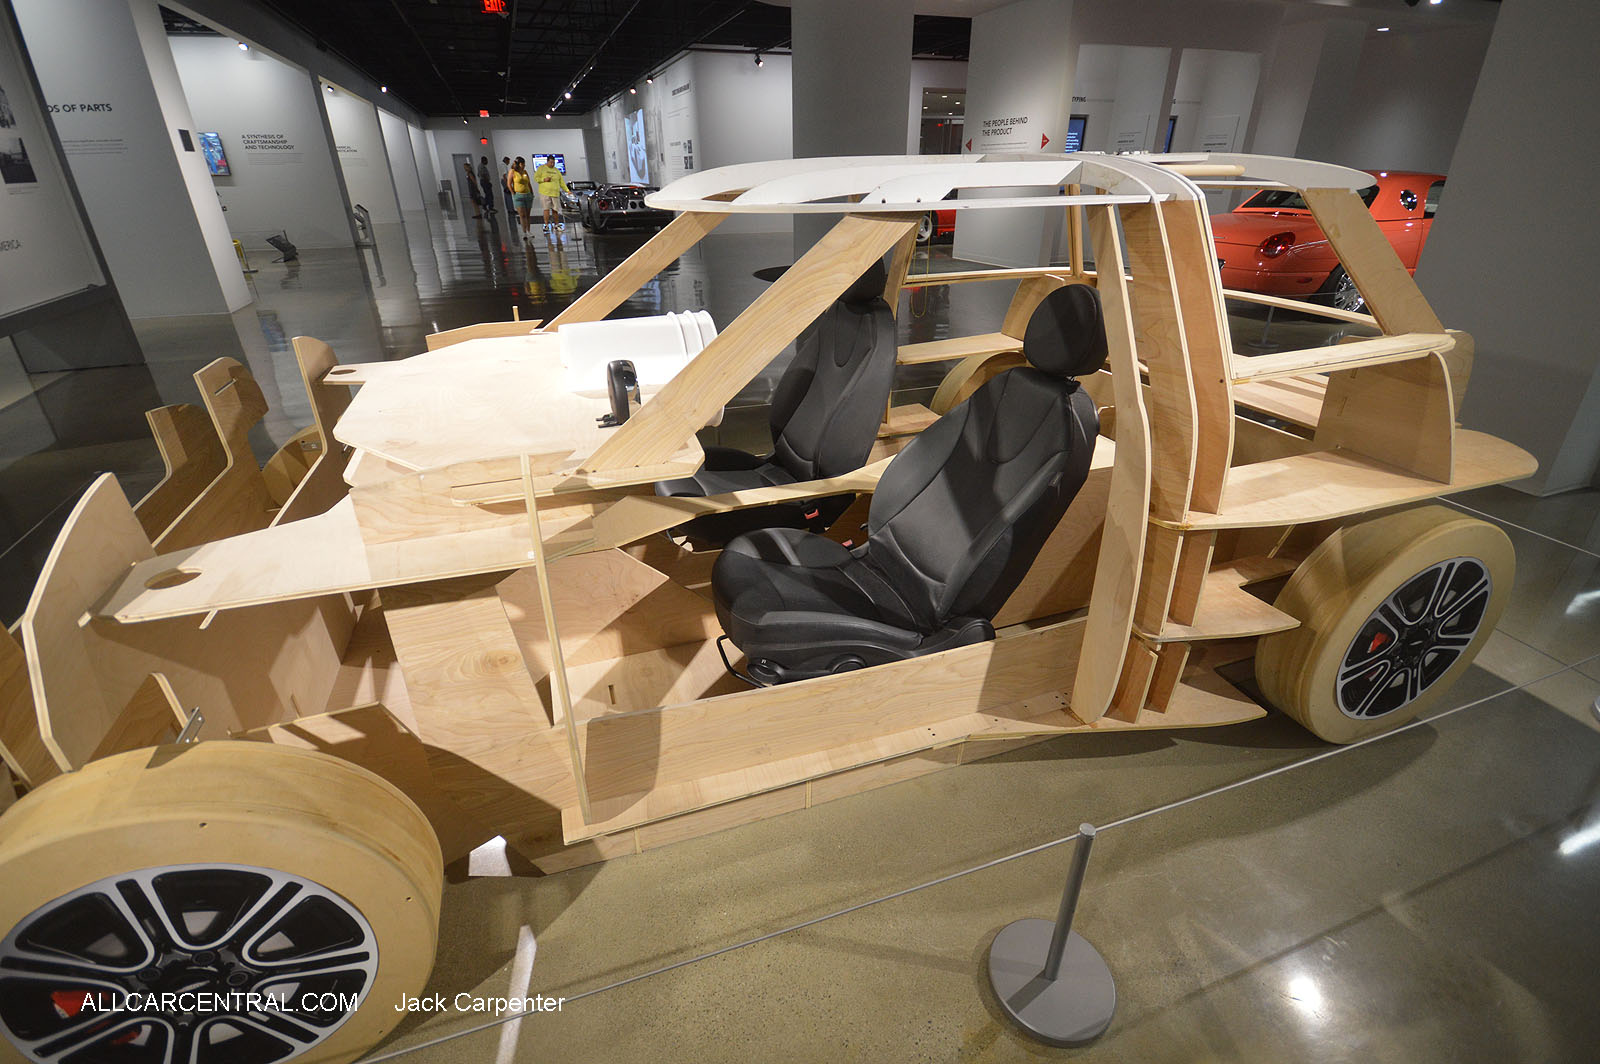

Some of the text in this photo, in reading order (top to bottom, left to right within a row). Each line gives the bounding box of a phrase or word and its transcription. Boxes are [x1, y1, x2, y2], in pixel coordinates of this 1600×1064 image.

[62, 103, 77, 113] OF
[79, 103, 113, 113] PARTS
[983, 116, 1028, 128] THE PEOPLE BEHIND
[990, 127, 1013, 136] PRODUCT
